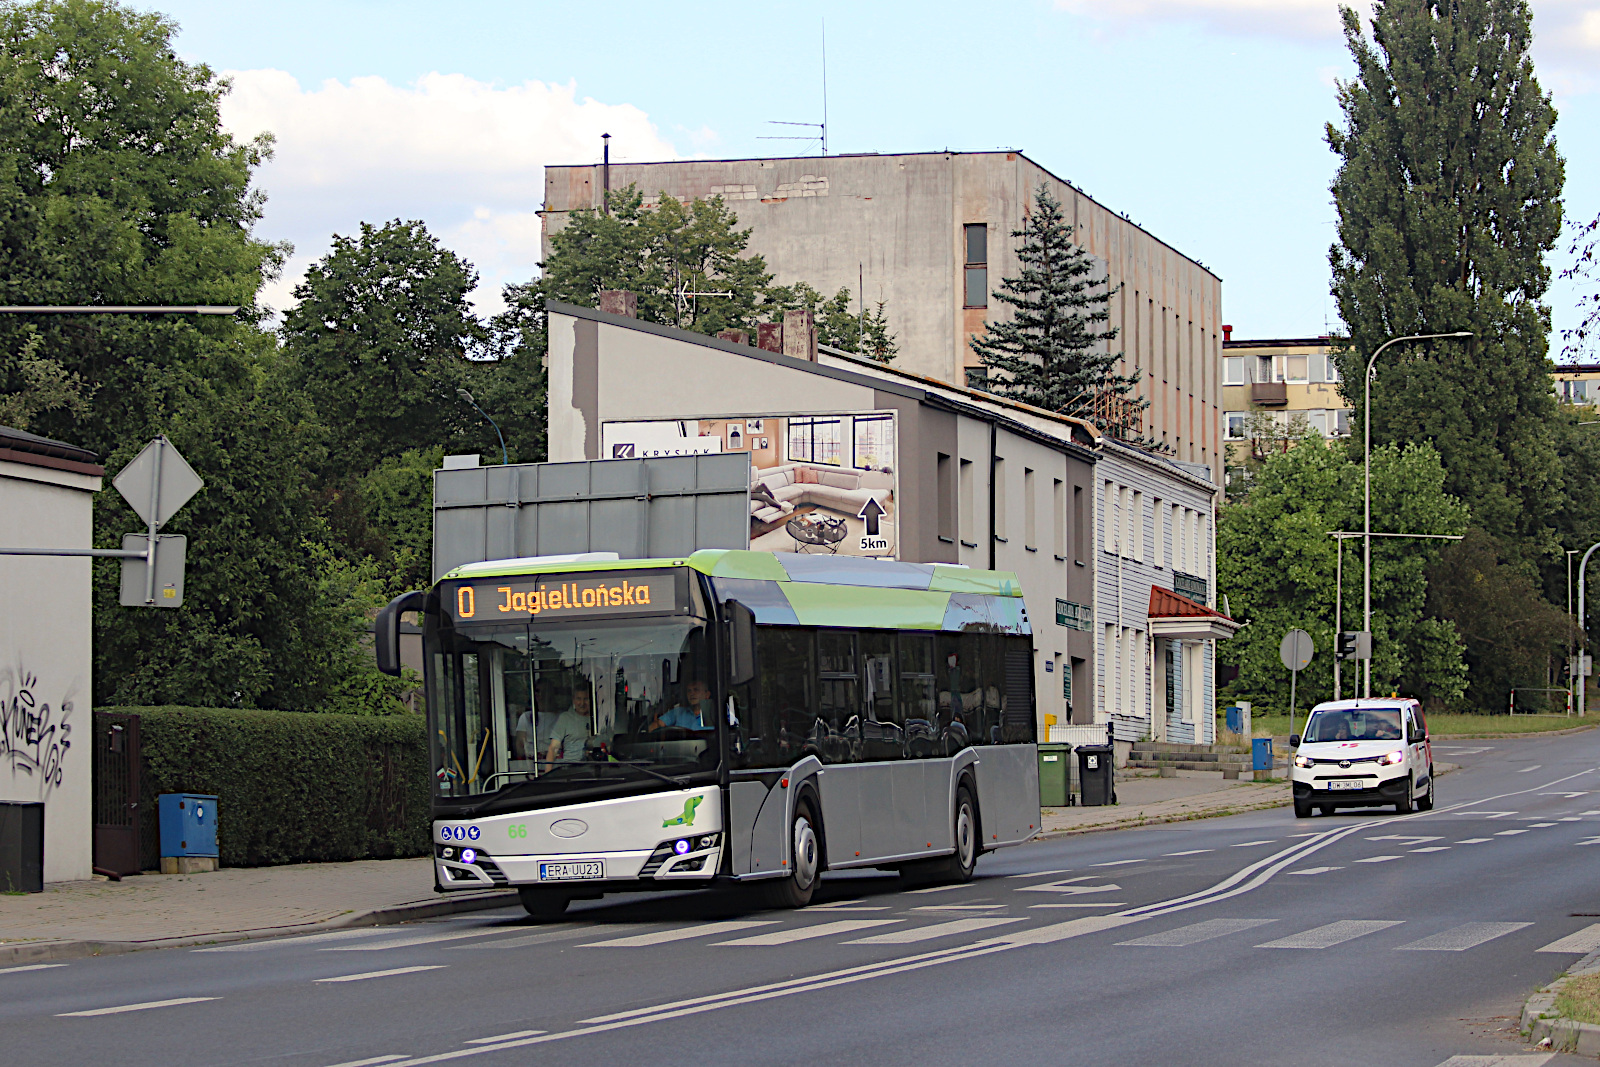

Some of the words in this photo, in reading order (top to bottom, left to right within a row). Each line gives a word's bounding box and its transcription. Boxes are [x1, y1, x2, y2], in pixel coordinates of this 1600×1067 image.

[860, 537, 887, 549] 5km
[497, 580, 651, 614] Jagiellońska
[507, 823, 528, 839] 66
[548, 865, 569, 877] ERA
[571, 863, 599, 876] UU23
